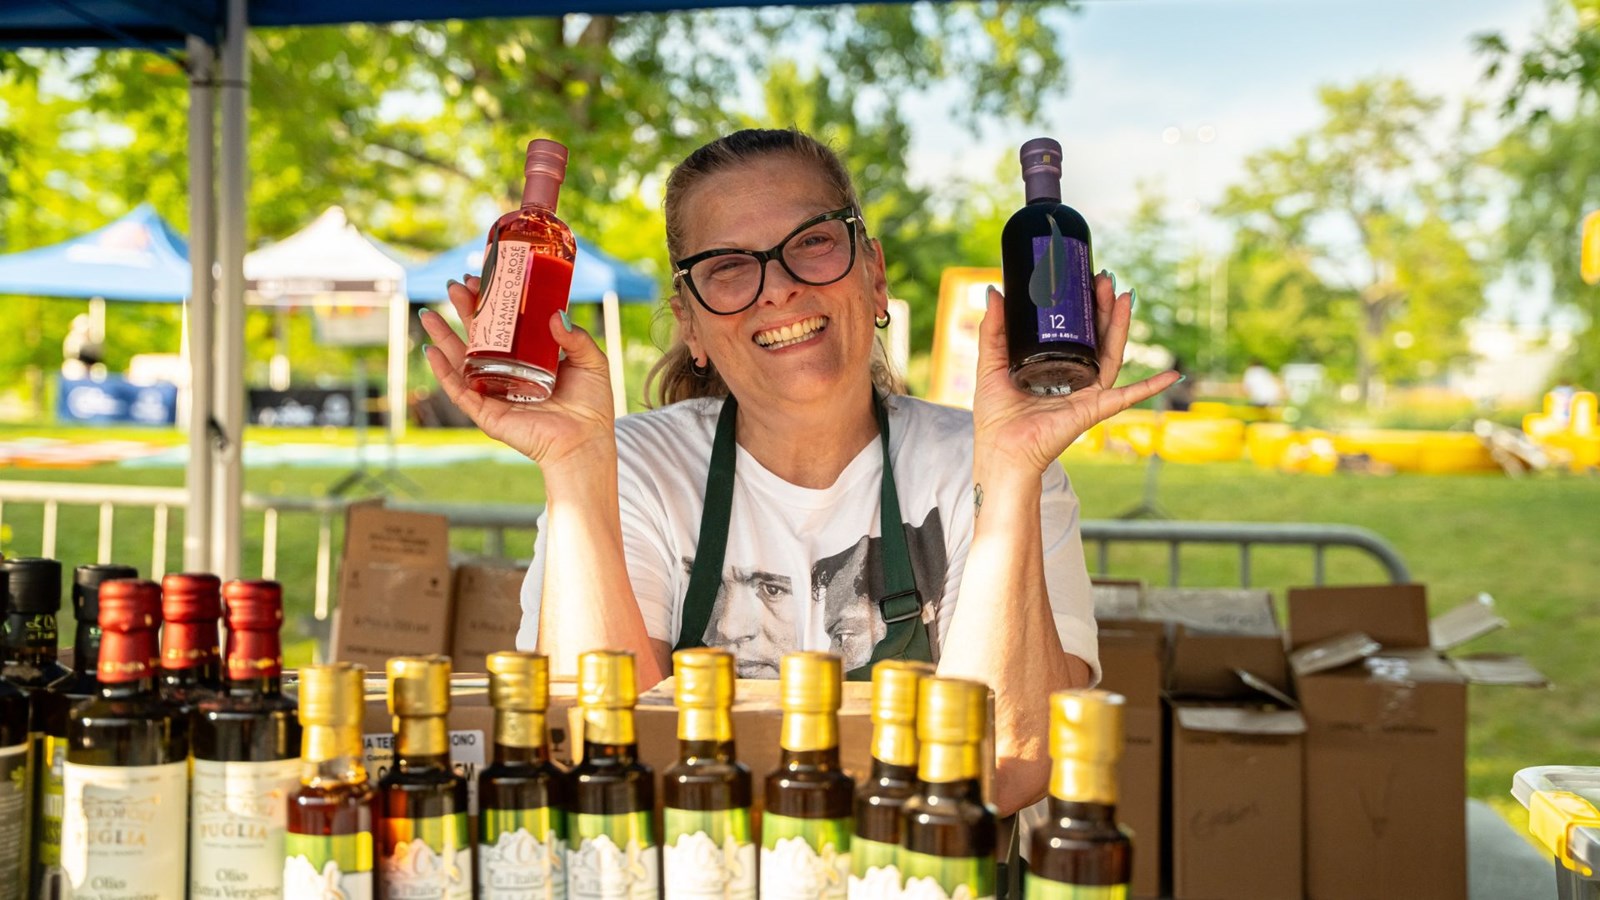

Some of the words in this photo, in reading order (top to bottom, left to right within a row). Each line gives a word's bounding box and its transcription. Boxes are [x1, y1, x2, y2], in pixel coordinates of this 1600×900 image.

[506, 291, 519, 326] BALSAMIC
[514, 246, 527, 287] CONDIMENT
[493, 280, 514, 347] BALSAMICO
[1049, 314, 1066, 329] 12
[201, 822, 268, 839] PUGLIA
[215, 867, 250, 882] Olio
[91, 876, 128, 891] Olio
[222, 884, 281, 899] Vergine
